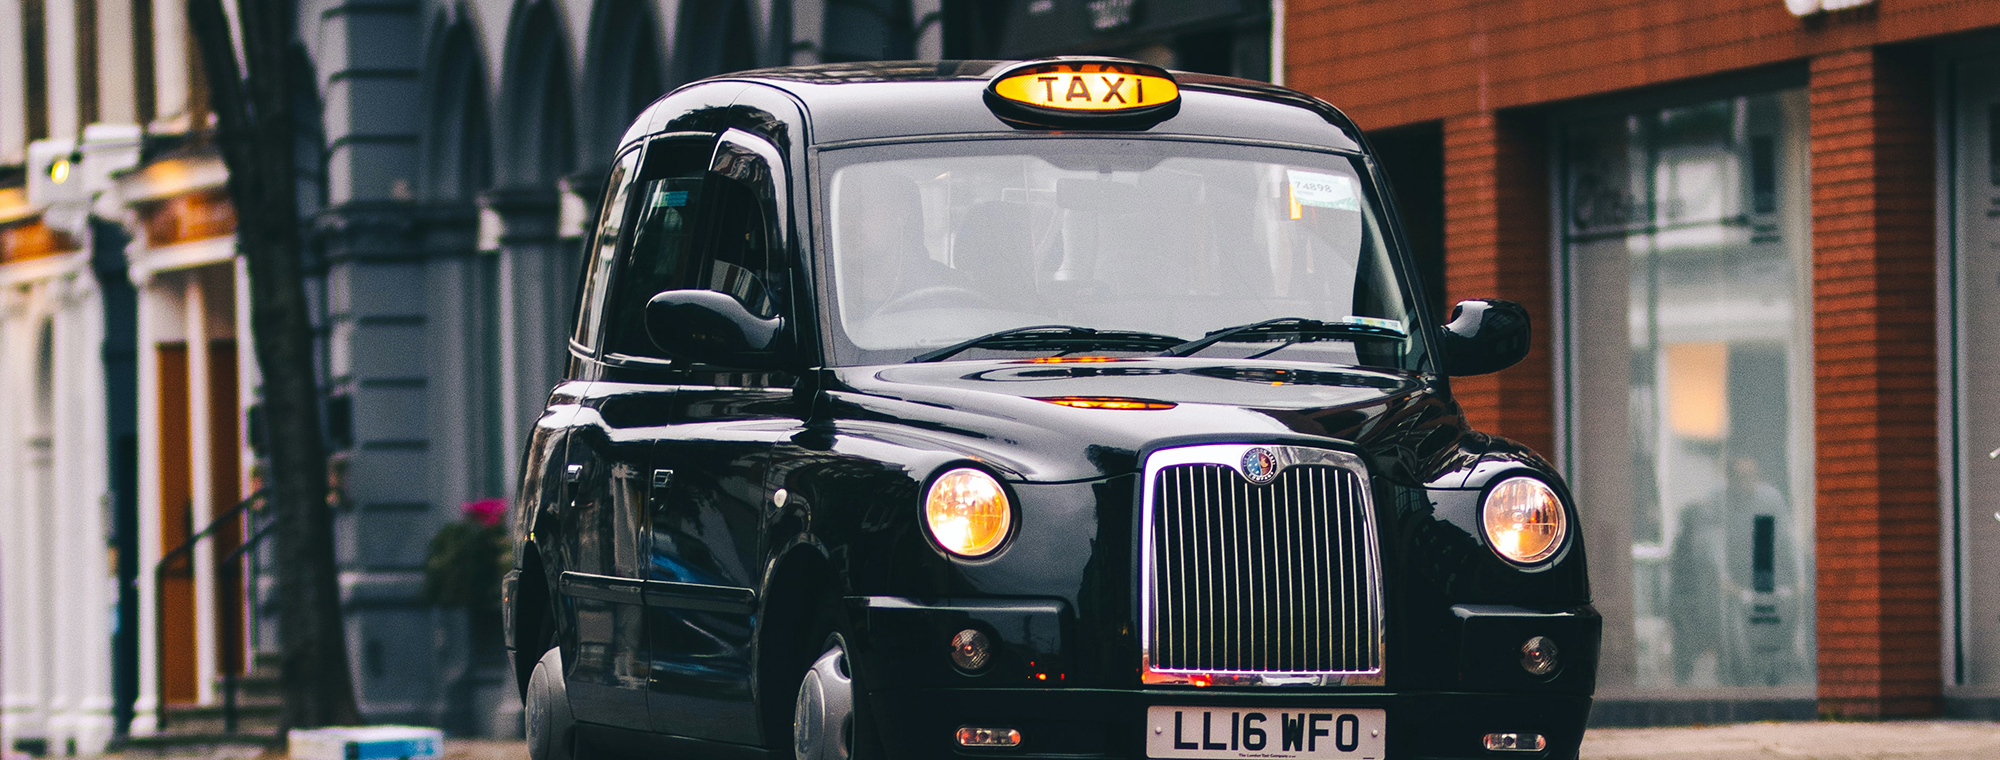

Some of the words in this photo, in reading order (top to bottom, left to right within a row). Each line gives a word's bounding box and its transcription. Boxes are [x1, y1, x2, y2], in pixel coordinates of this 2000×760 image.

[1038, 76, 1143, 104] TAXI
[1295, 181, 1332, 193] 74898
[1173, 711, 1267, 751] LL16
[1281, 712, 1360, 752] WFO
